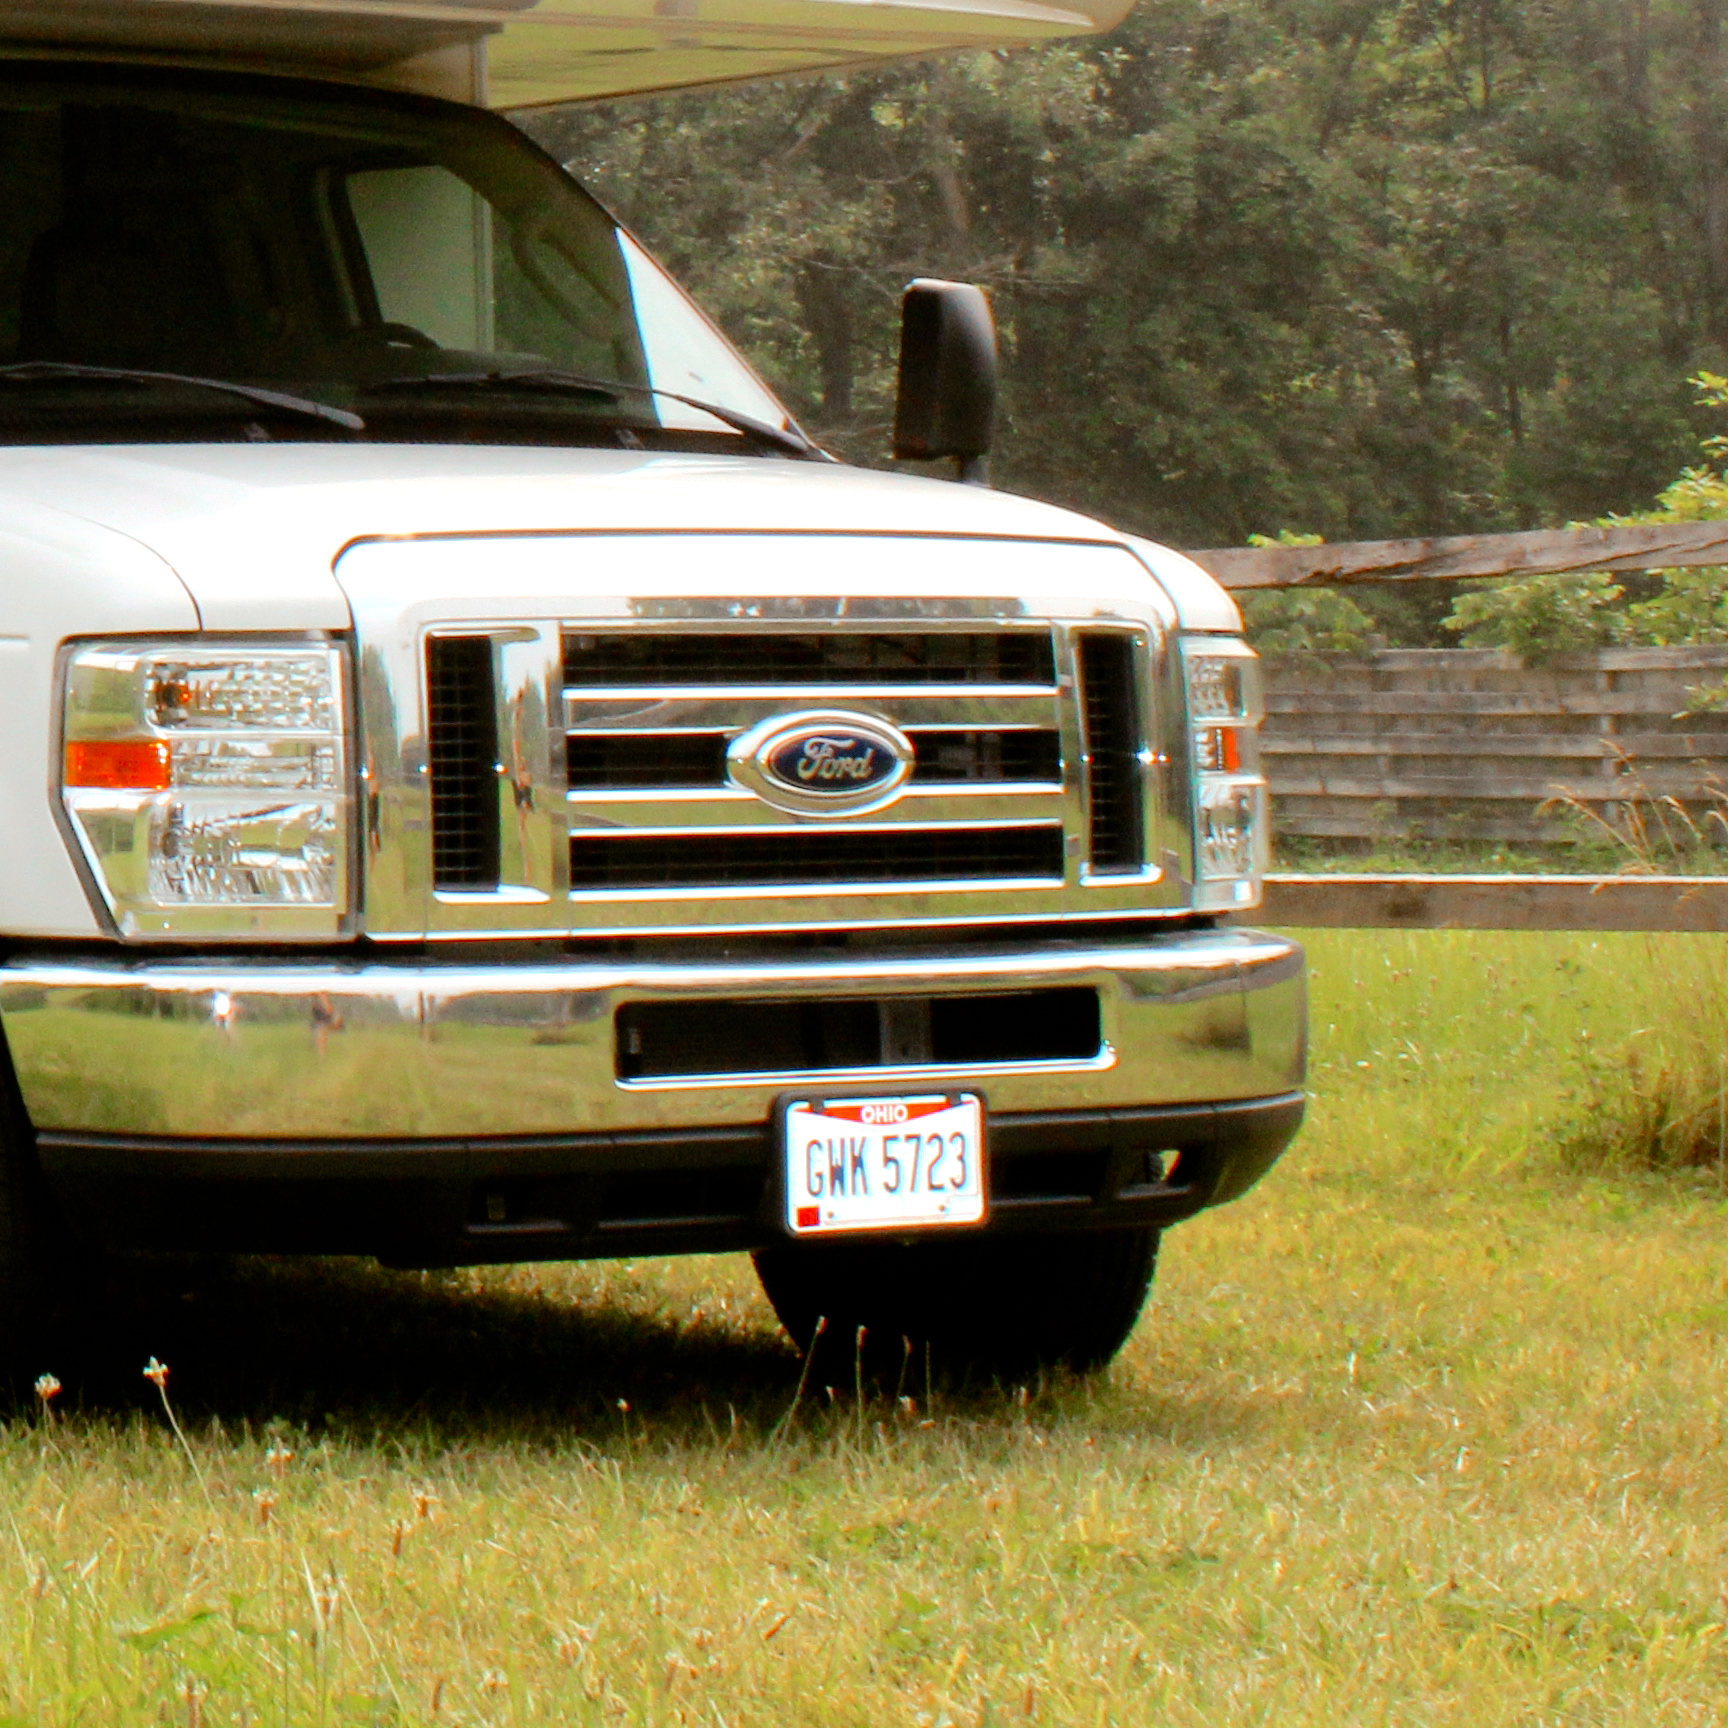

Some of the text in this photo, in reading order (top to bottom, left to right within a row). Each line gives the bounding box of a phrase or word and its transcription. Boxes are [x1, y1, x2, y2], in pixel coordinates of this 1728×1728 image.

[797, 736, 876, 780] Ford
[860, 1104, 909, 1124] OHIO
[806, 1130, 967, 1198] GWK 5723
